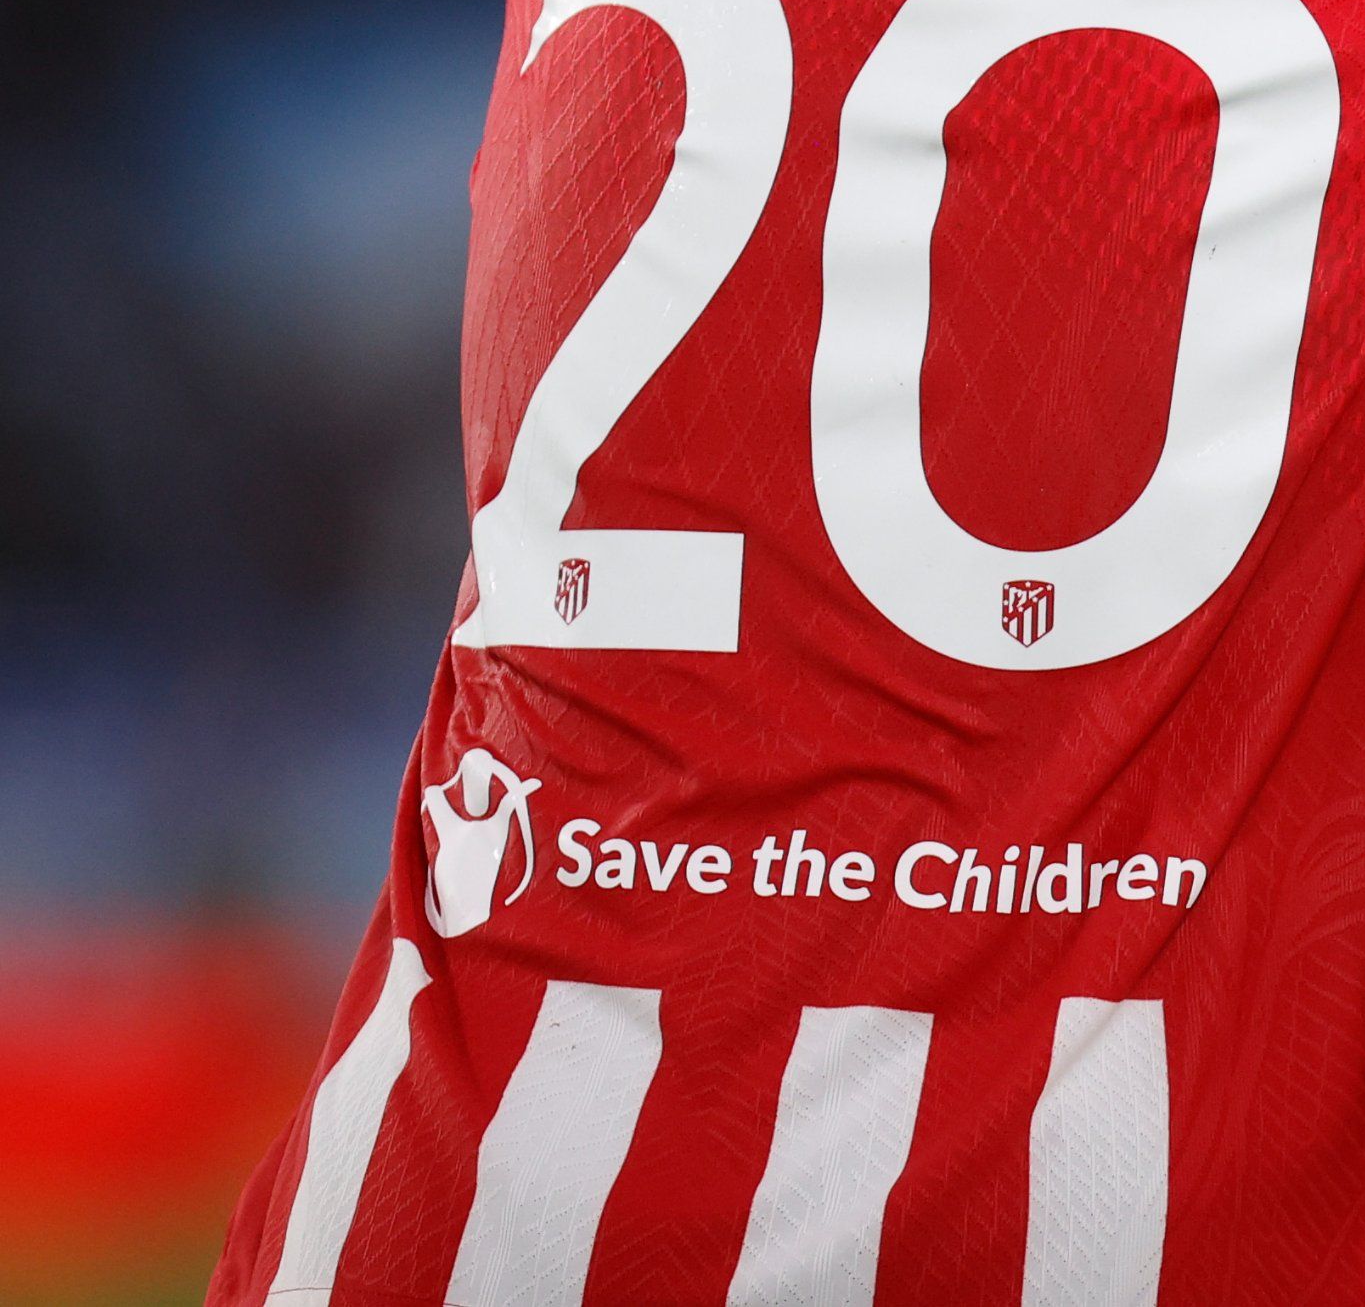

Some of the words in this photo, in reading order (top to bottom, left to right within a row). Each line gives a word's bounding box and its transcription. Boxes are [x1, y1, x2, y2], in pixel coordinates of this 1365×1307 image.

[556, 818, 733, 894] Save
[752, 829, 876, 902] the
[894, 841, 1207, 914] Children
